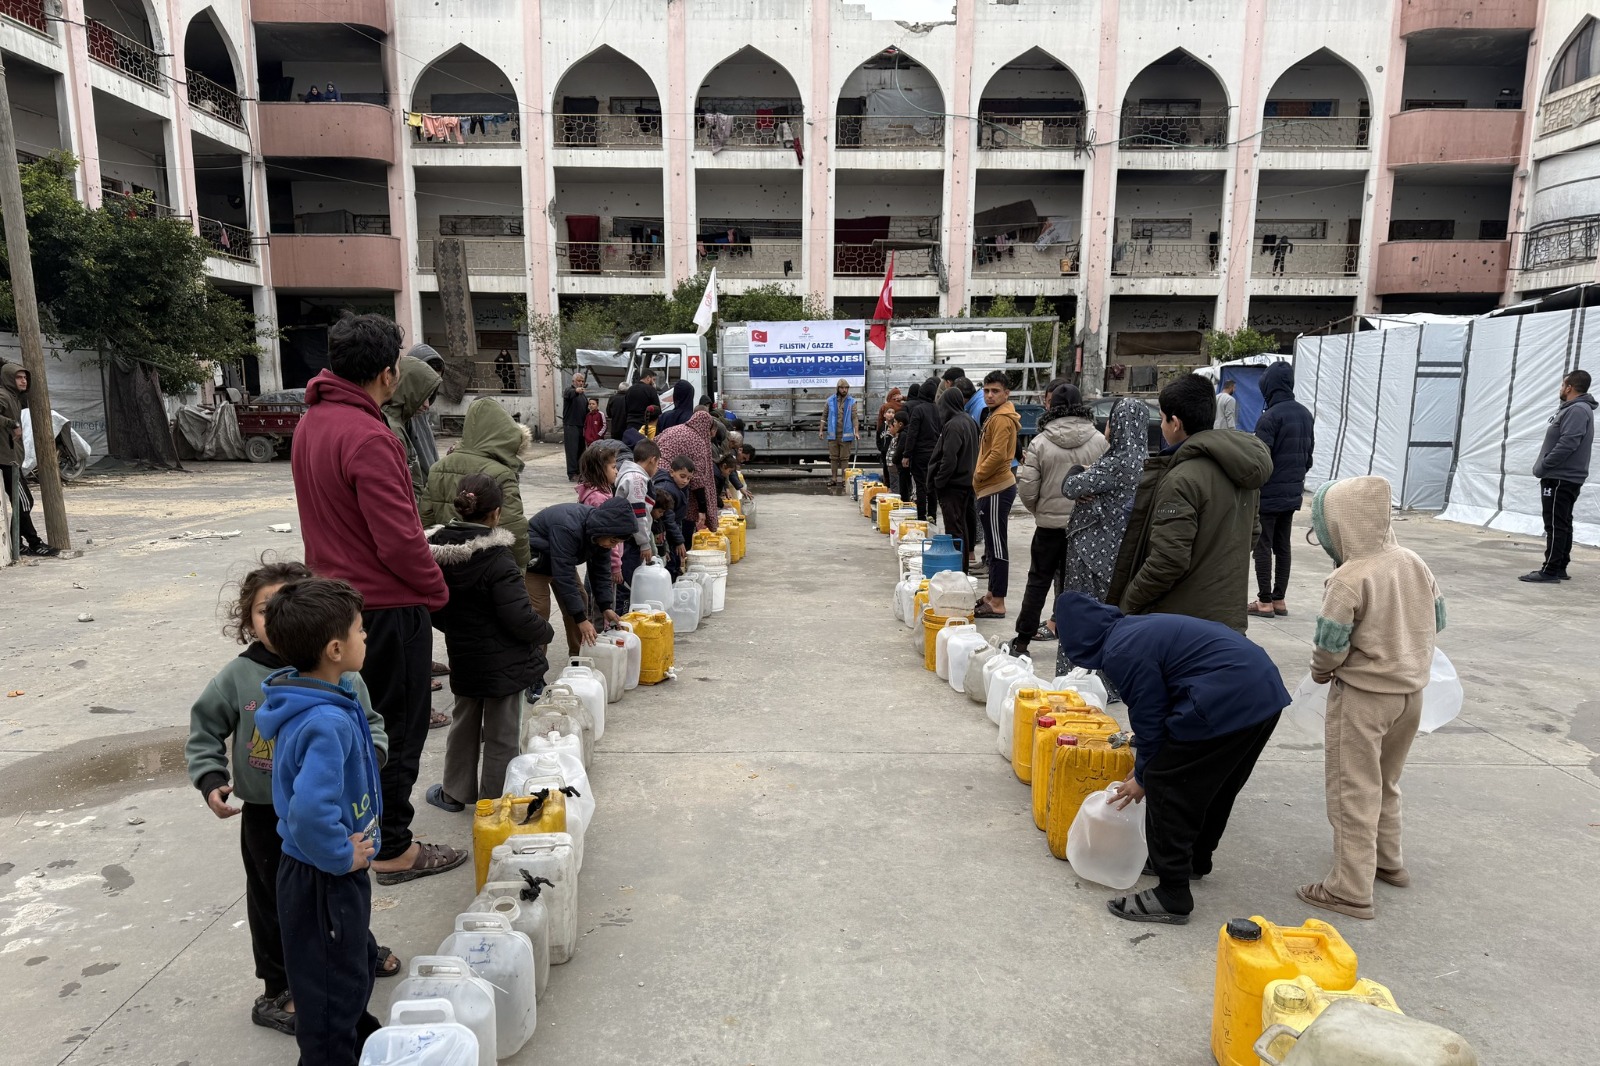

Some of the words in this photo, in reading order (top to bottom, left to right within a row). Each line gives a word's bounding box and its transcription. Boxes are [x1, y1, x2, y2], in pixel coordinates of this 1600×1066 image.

[770, 356, 815, 364] DAĞITIM
[818, 354, 862, 363] PROJESİ
[787, 365, 813, 375] توزيع
[819, 364, 852, 375] مشروع
